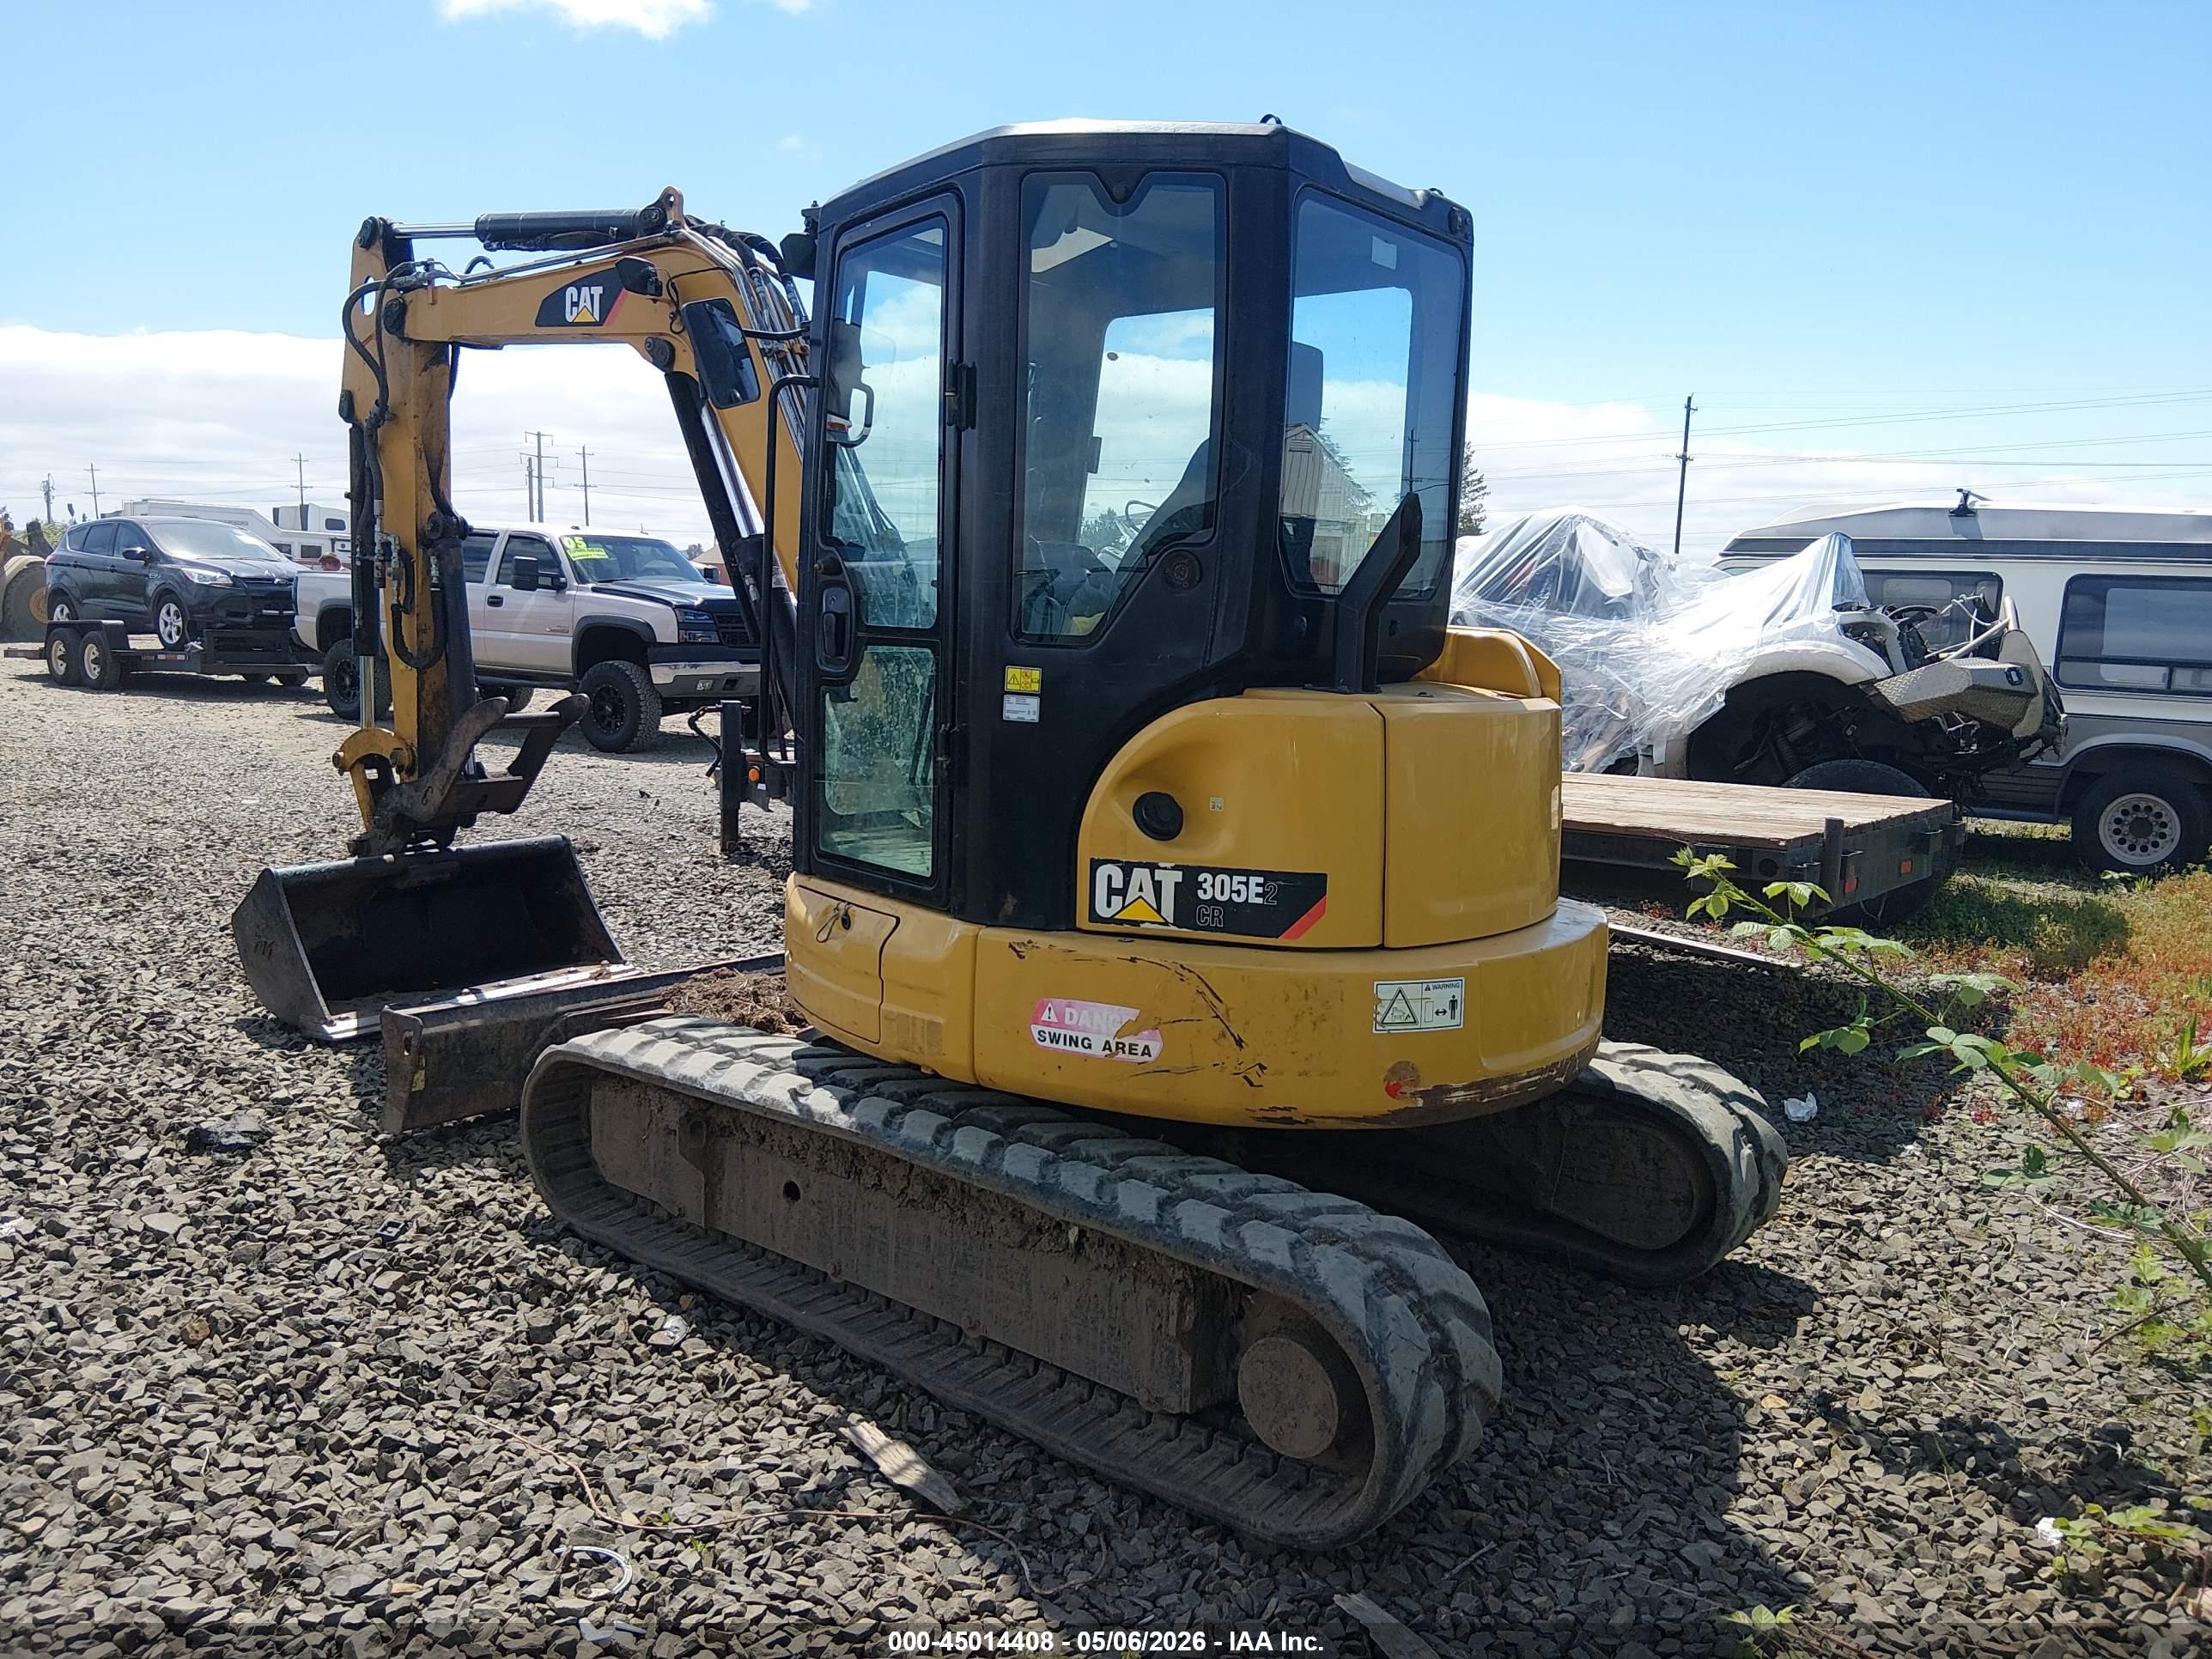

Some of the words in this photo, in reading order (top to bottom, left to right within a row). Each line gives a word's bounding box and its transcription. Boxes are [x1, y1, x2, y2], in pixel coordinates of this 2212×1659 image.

[565, 286, 604, 323] CAT
[1095, 864, 1183, 924] CAT
[1197, 872, 1278, 906] 305E2
[1195, 905, 1224, 927] CR
[1431, 981, 1461, 991] WARNING
[1037, 1030, 1092, 1050] SWING
[1102, 1040, 1152, 1057] AREA
